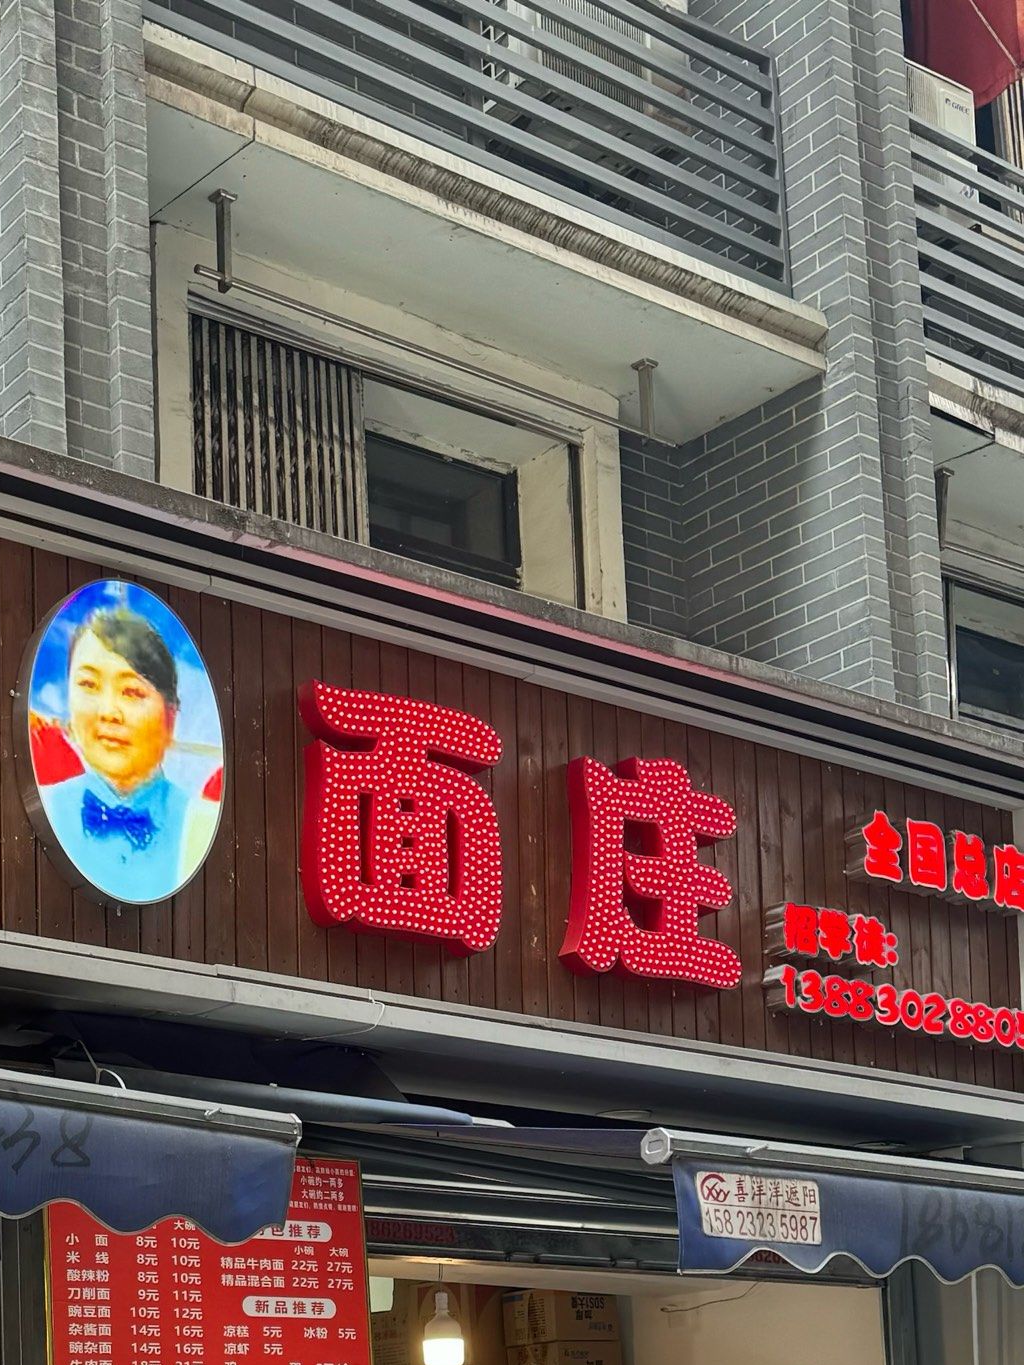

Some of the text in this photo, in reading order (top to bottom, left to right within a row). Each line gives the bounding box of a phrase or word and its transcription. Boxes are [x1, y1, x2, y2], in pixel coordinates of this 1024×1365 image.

[735, 1177, 817, 1207] 喜洋洋遮阳
[174, 1220, 196, 1231] 大碗
[259, 1224, 321, 1239] 色推荐
[706, 1207, 818, 1242] 158 2323 5987
[136, 1236, 157, 1248] 8元
[171, 1237, 200, 1250] 10元
[294, 1246, 349, 1257] 小碗 大碗
[137, 1254, 158, 1266] 8元
[172, 1255, 200, 1267] 10元
[220, 1256, 353, 1274] 精品牛肉面 22元 27元
[66, 1269, 201, 1285] 酸辣粉 8元 10元
[221, 1273, 354, 1291] 精品混合面 22元 27元
[67, 1287, 202, 1302] 刀削面 9元 11元
[130, 1307, 160, 1319] 10元
[174, 1308, 203, 1320] 12元
[255, 1300, 325, 1315] 新品推荐
[68, 1323, 204, 1338] 杂酱面 14元 16元
[223, 1325, 356, 1340] 凉糕 5元 冰粉 5元
[131, 1342, 161, 1355] 14元
[175, 1343, 204, 1355] 16元
[224, 1343, 283, 1355] 凉虾 5元
